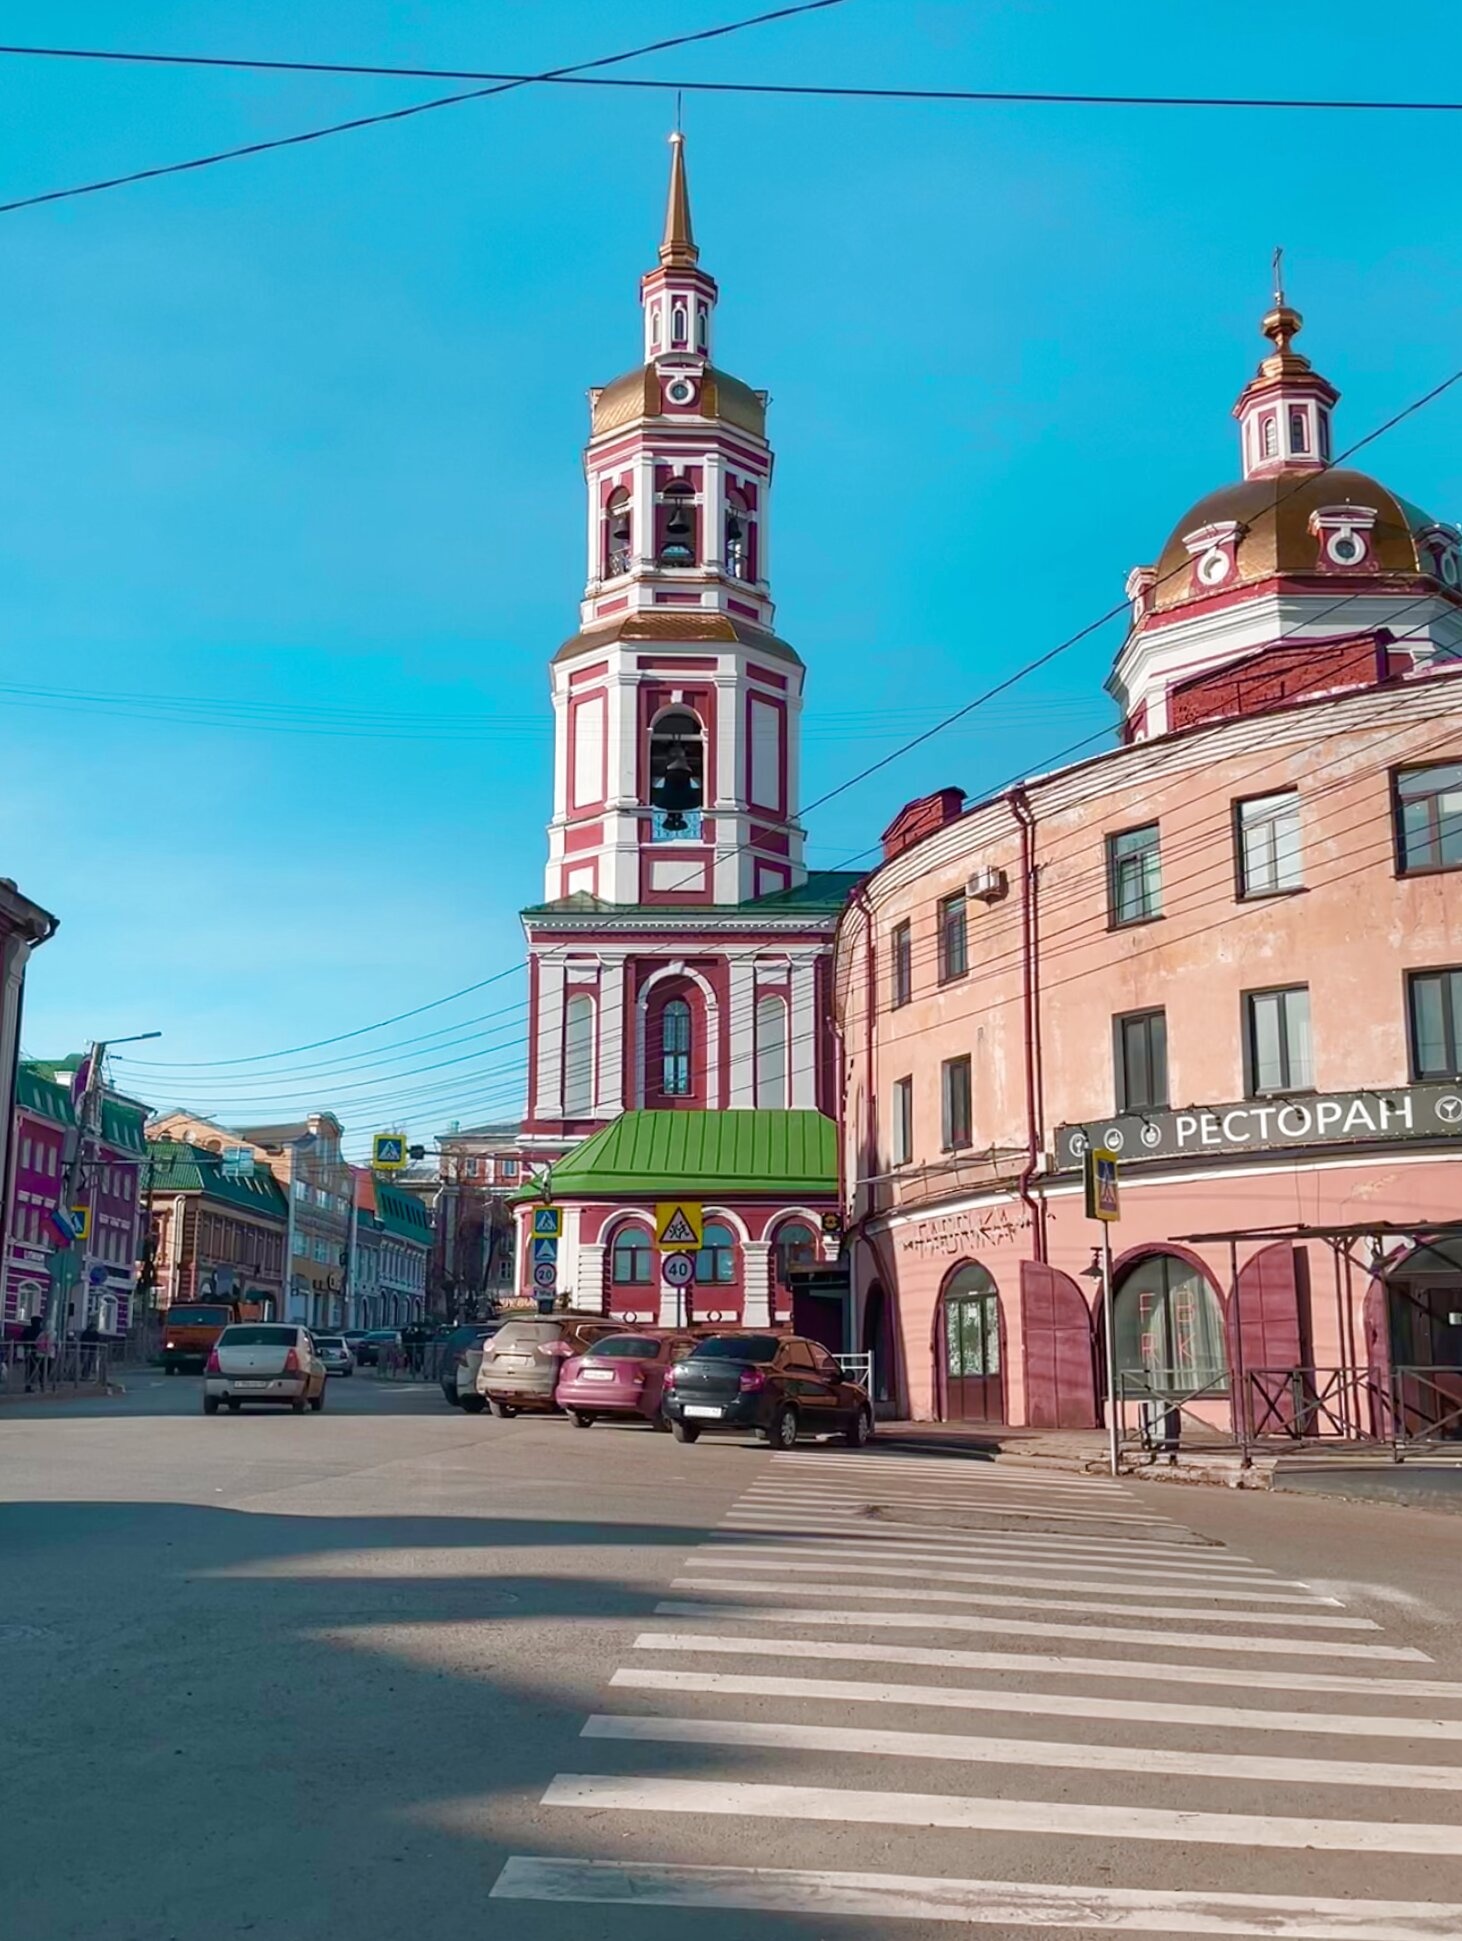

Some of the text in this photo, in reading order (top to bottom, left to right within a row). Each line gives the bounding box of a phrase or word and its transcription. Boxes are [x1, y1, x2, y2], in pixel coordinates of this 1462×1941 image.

[1177, 1095, 1414, 1147] РЕСТОРАН
[538, 1269, 553, 1280] 20
[668, 1262, 688, 1277] 40
